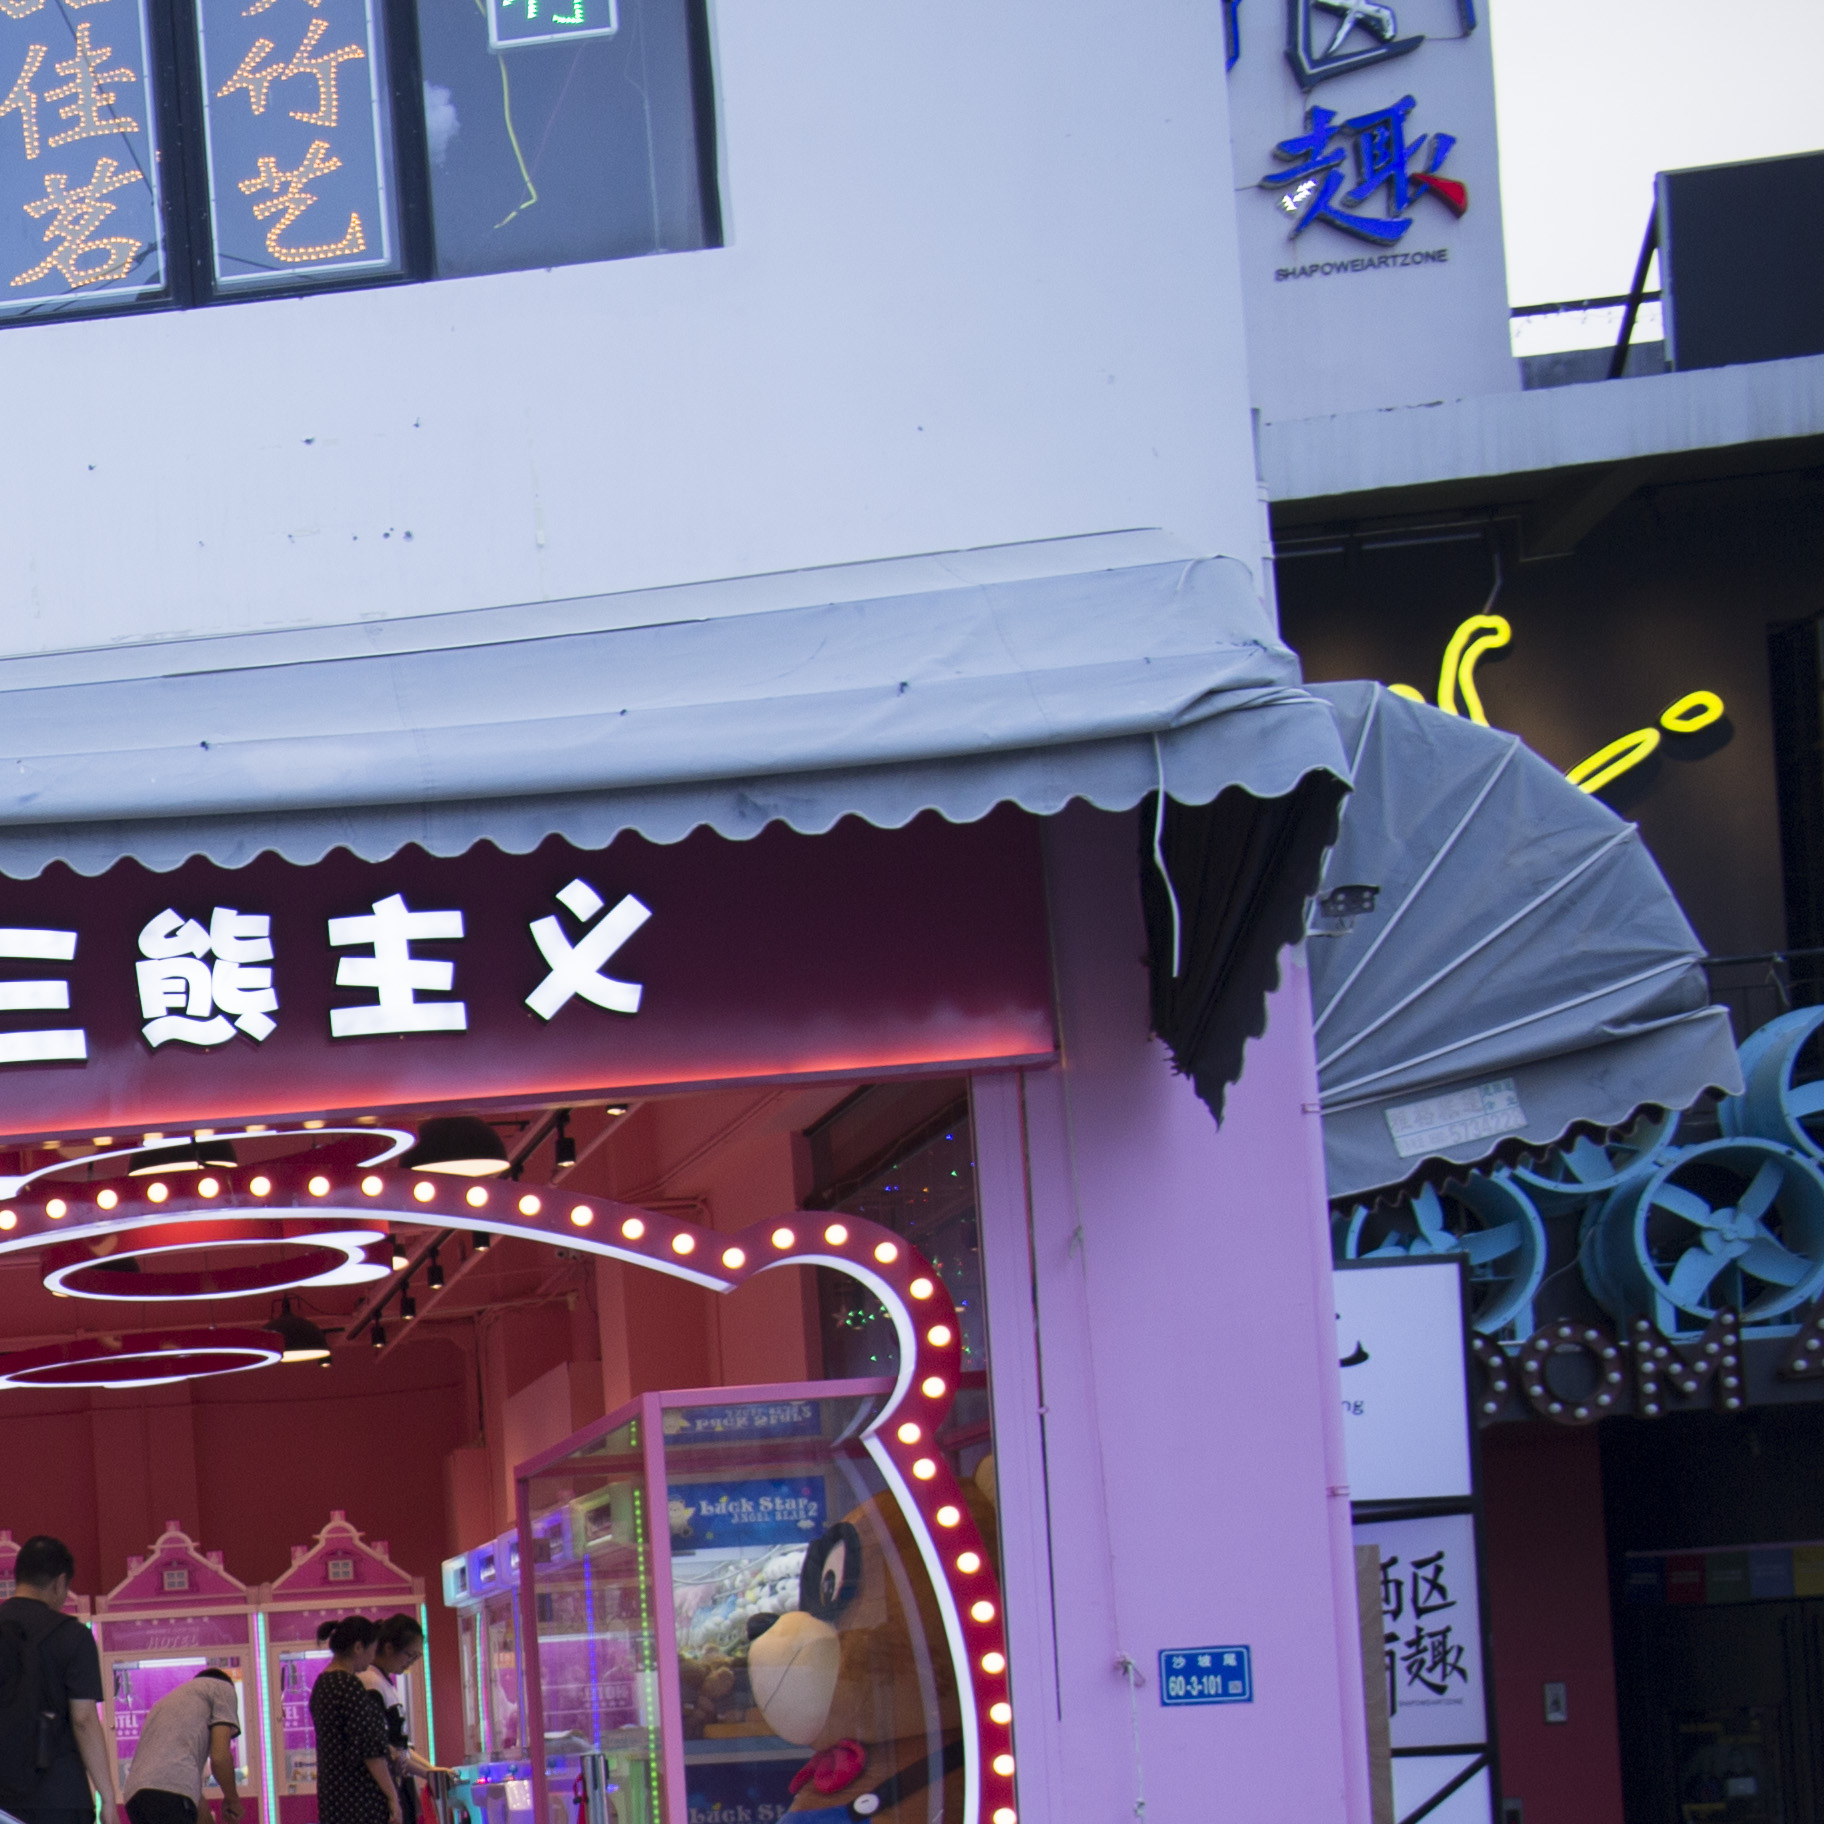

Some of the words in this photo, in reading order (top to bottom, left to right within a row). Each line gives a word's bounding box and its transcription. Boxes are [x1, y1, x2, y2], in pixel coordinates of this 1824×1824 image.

[215, 0, 367, 264] 竹艺
[1257, 94, 1469, 247] 趣
[1273, 248, 1449, 282] SHAPOWEIARTZONE
[1168, 1675, 1222, 1696] 60-3-101
